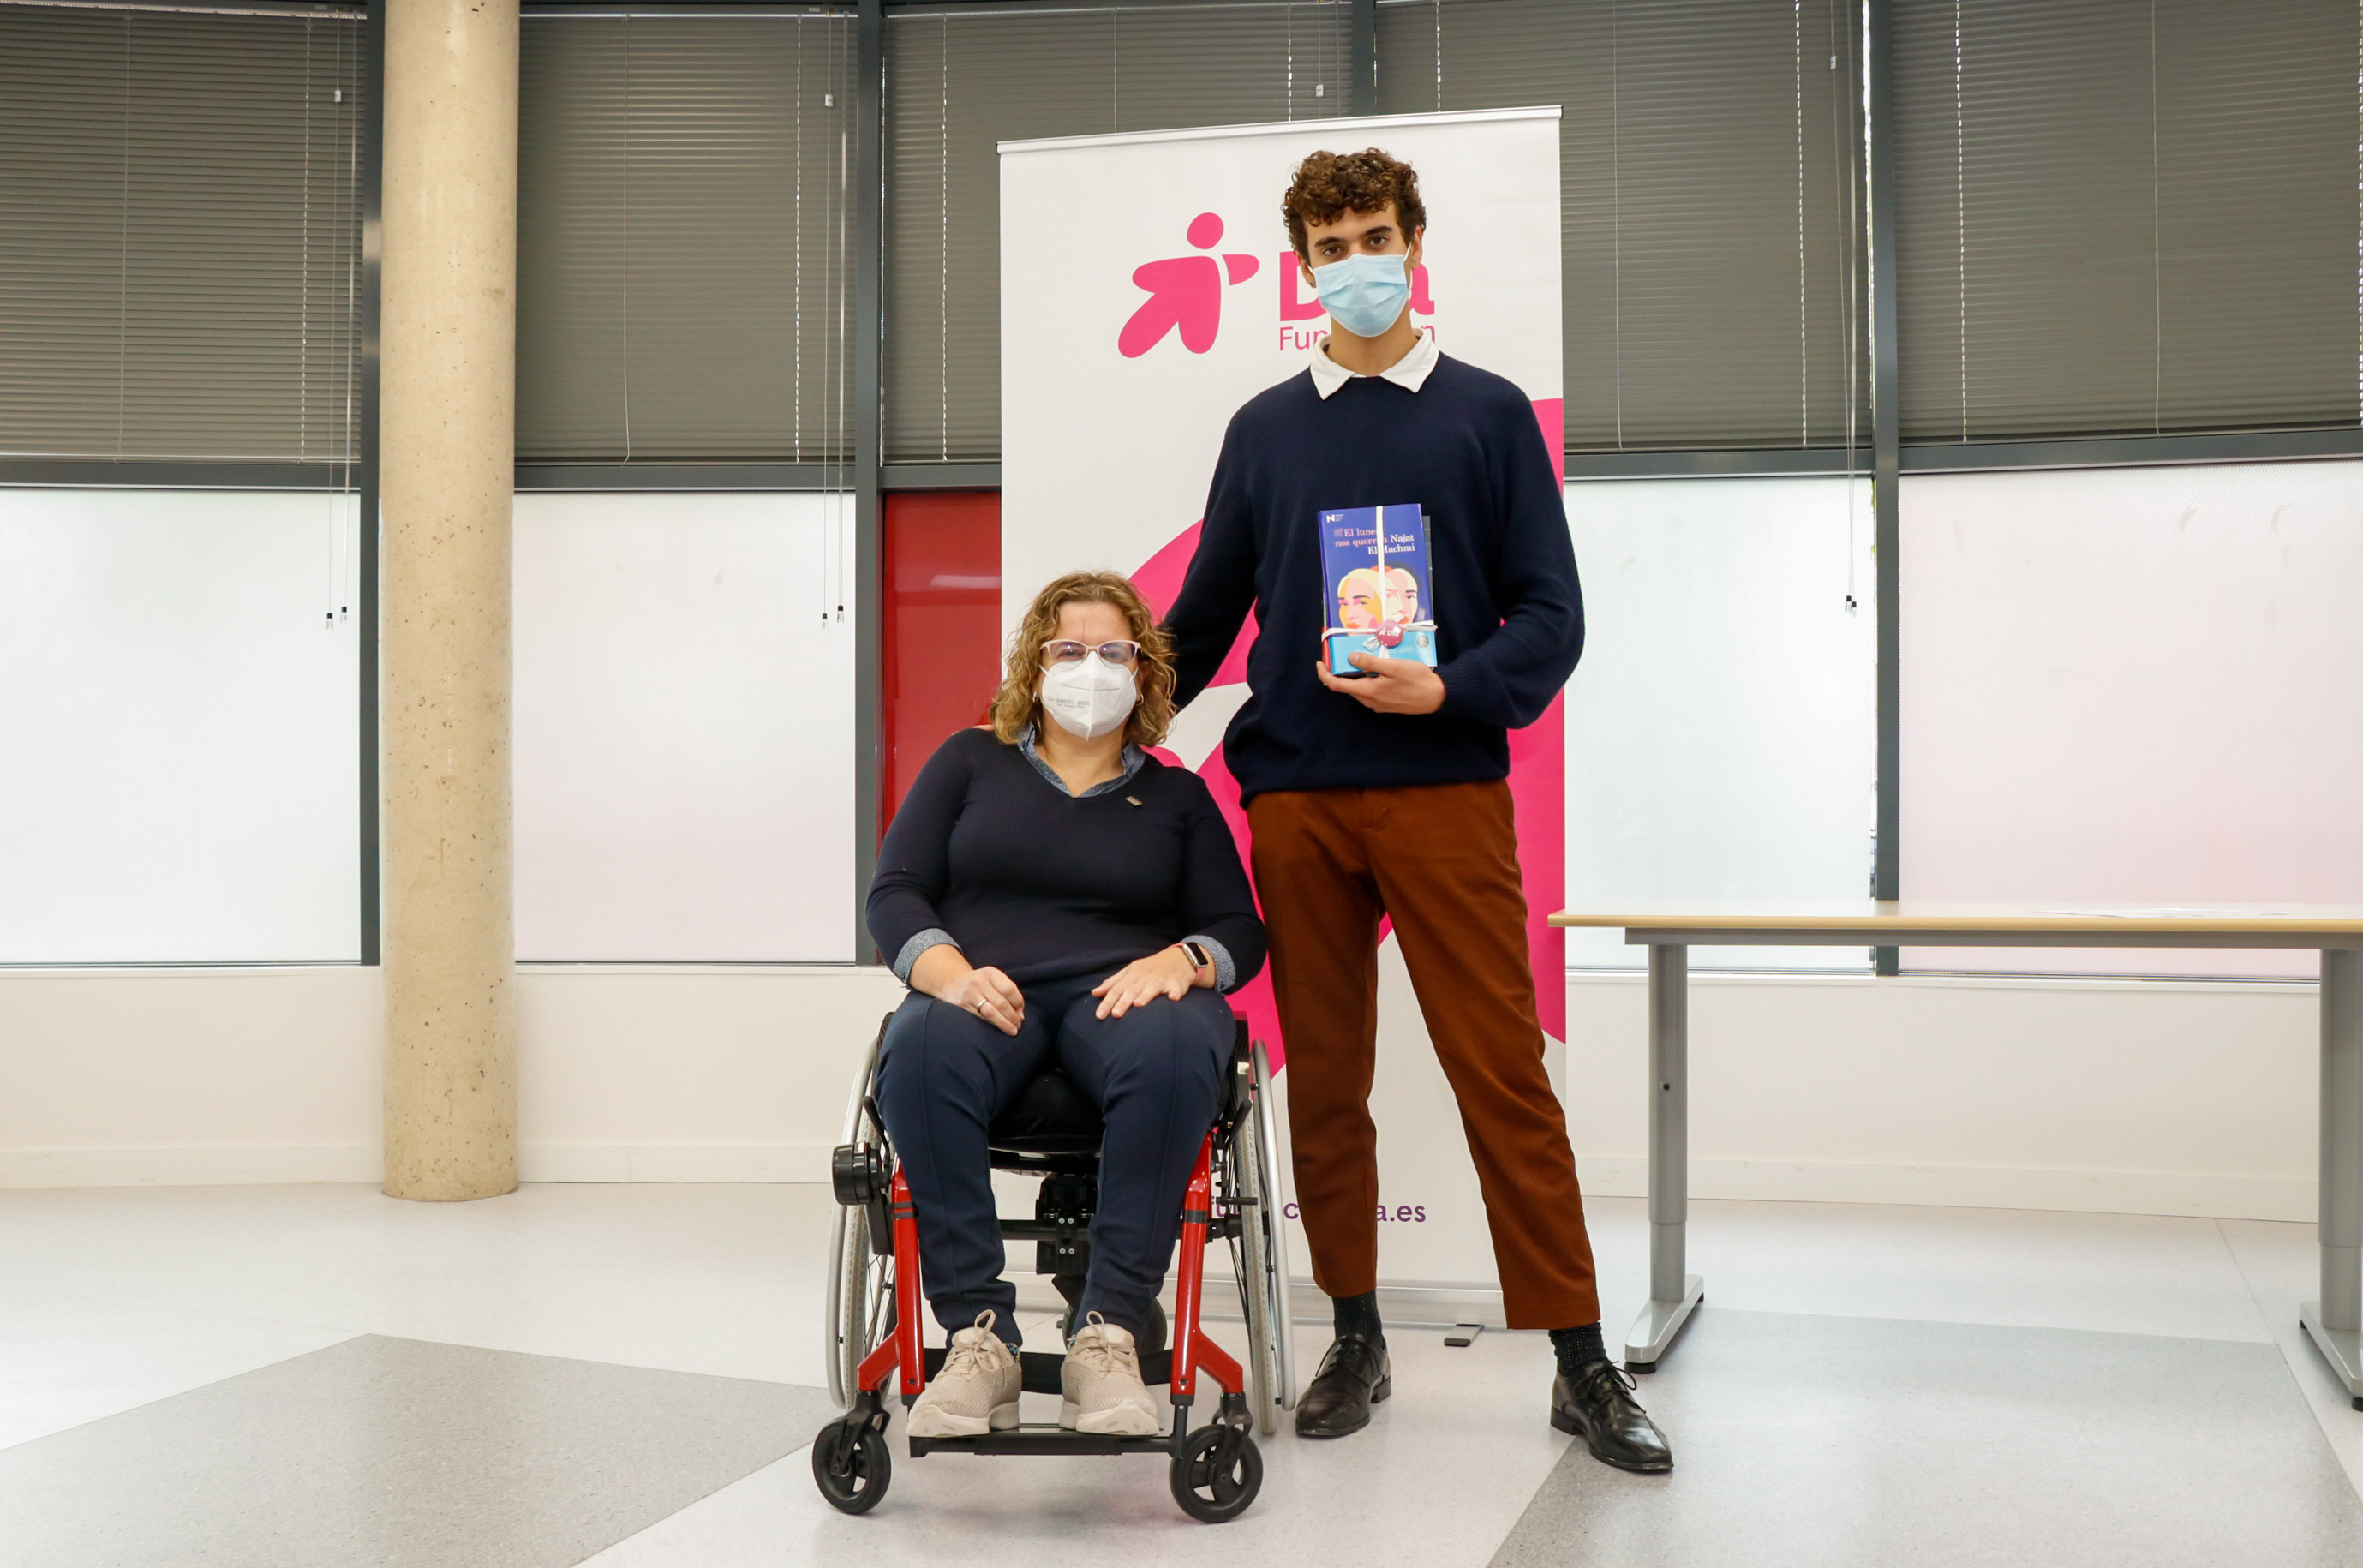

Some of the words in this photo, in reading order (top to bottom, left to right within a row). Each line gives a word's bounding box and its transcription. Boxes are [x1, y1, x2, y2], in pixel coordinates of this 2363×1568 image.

[1344, 528, 1354, 536] El
[1356, 527, 1378, 536] lune
[1352, 536, 1387, 547] querrn
[1390, 534, 1415, 544] Najat
[1367, 545, 1378, 554] El
